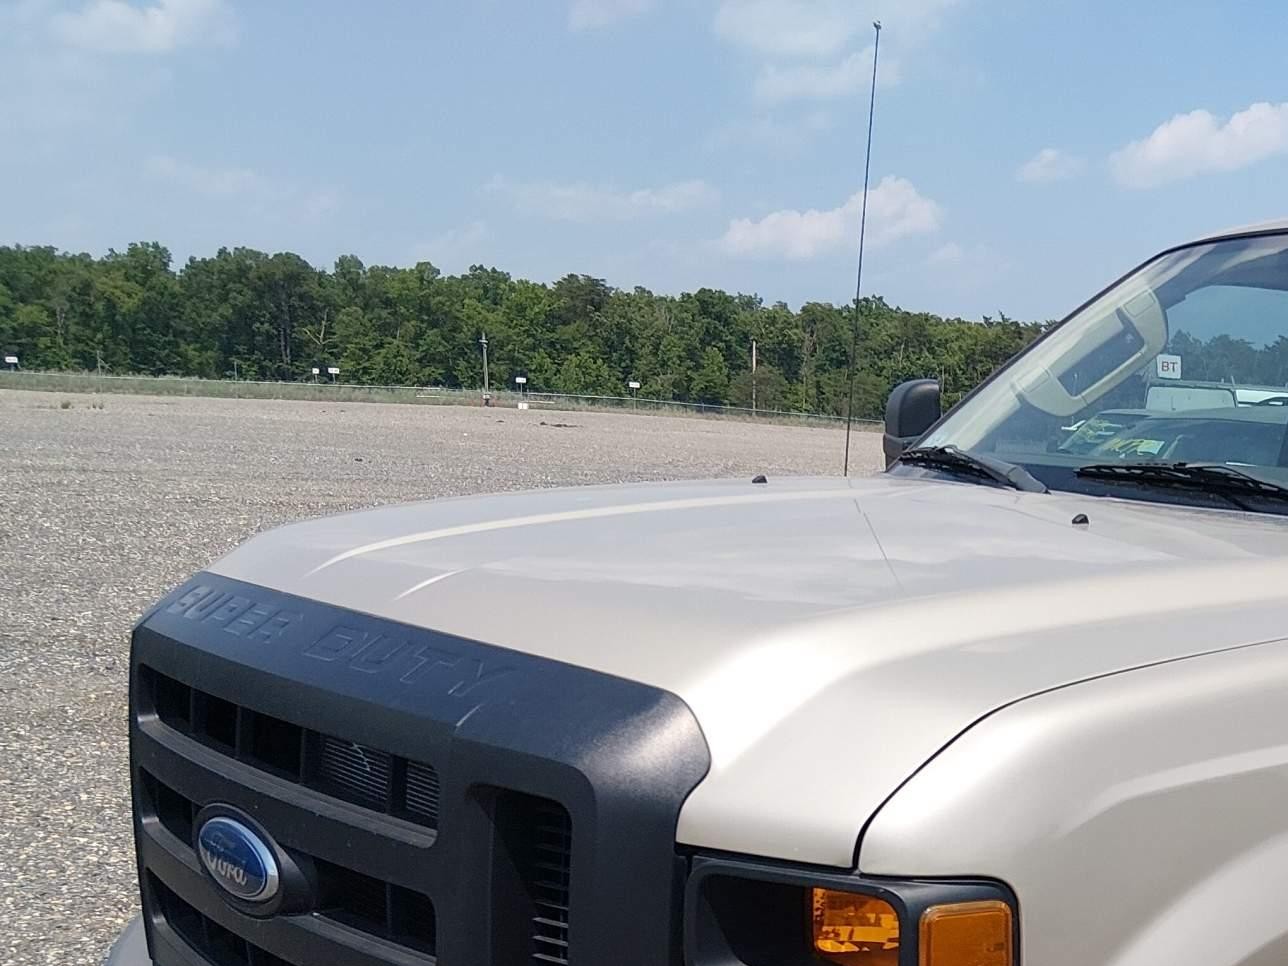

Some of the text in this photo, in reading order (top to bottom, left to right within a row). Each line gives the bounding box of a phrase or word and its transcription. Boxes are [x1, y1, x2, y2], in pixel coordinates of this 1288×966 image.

[1161, 361, 1178, 373] BT
[166, 585, 513, 698] SUPER DUTY
